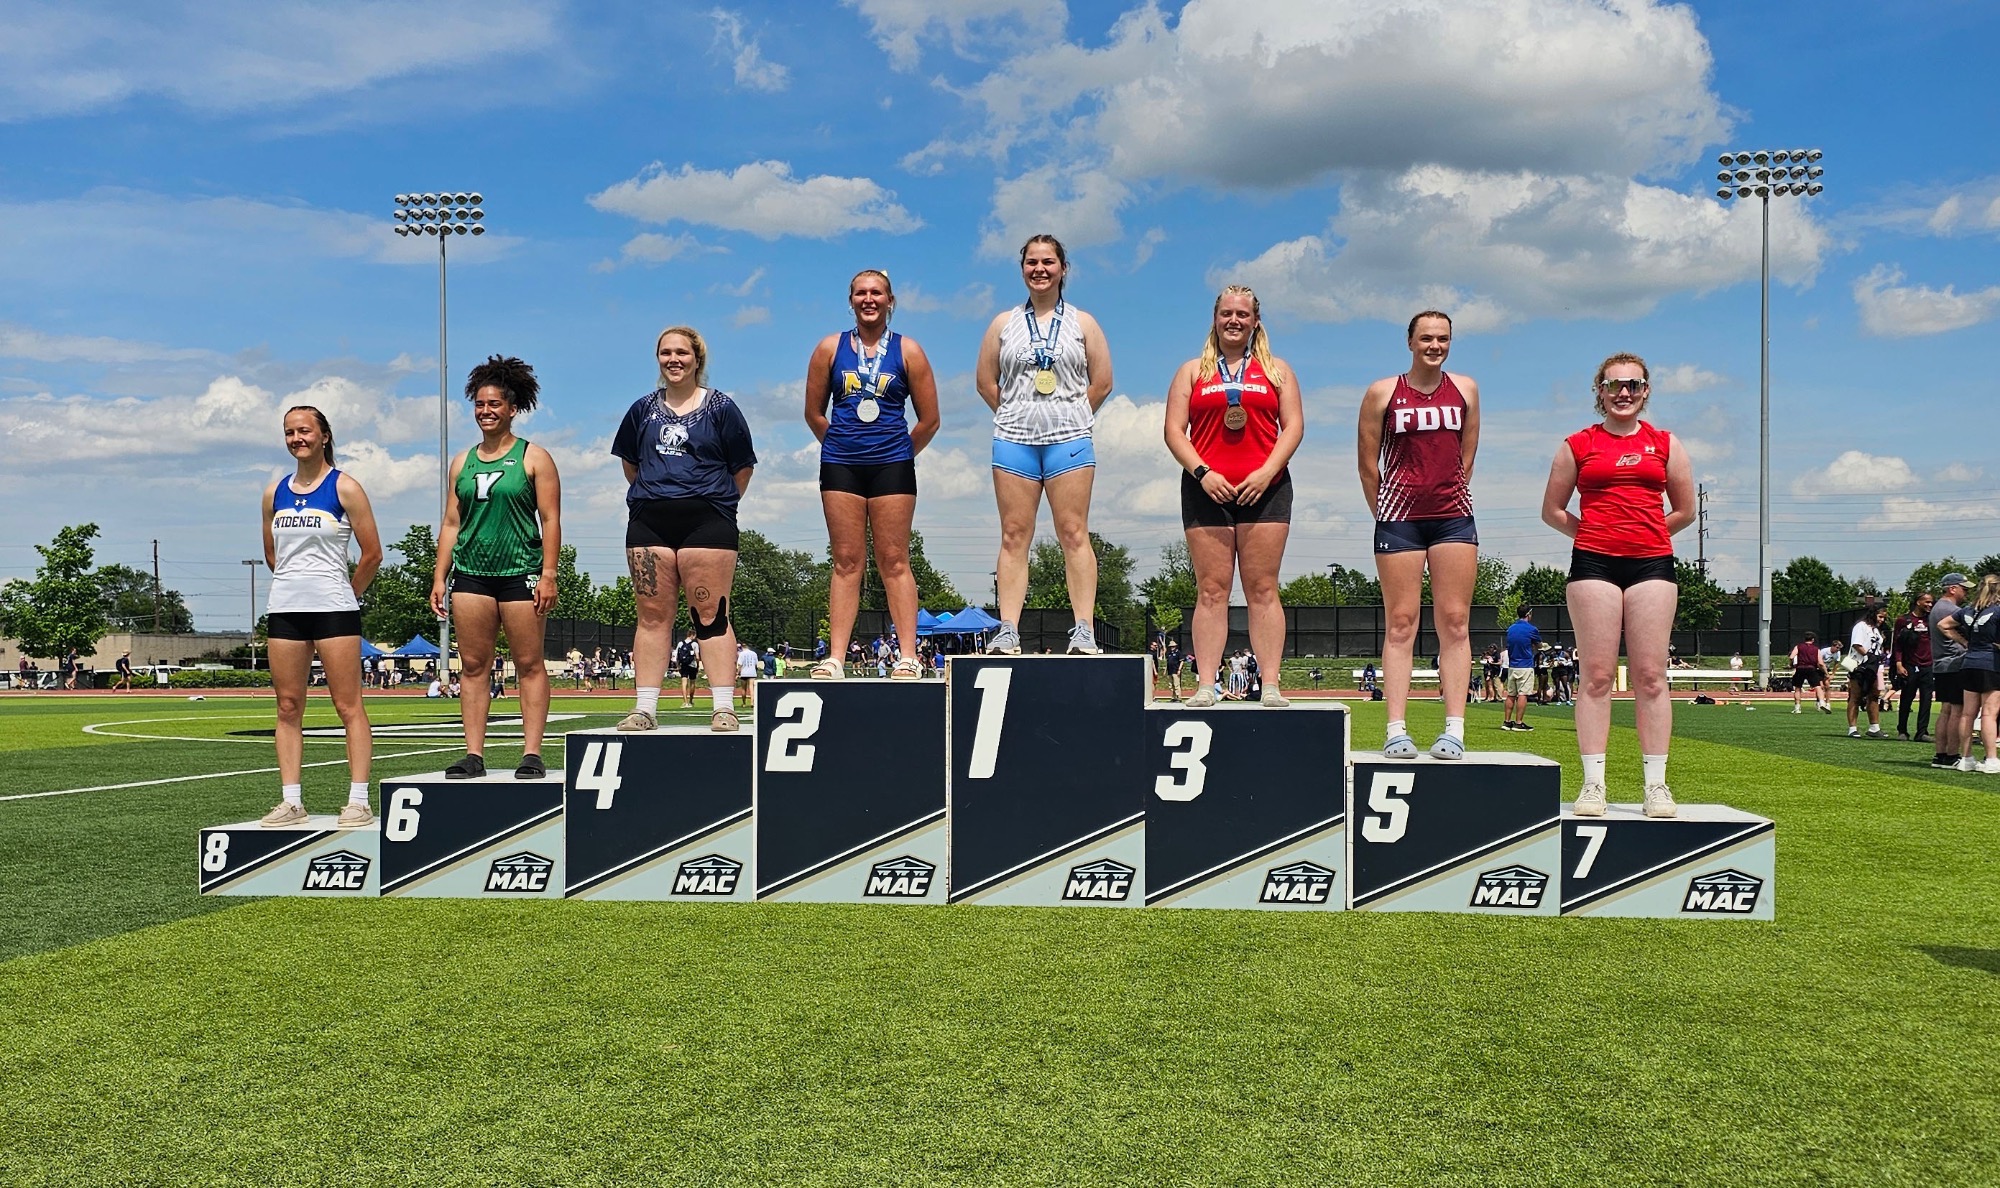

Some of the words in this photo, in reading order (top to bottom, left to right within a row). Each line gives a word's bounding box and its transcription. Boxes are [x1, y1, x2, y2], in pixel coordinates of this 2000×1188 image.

[1201, 383, 1268, 396] MONCHS
[1394, 406, 1462, 434] FDU
[472, 470, 505, 502] Y
[274, 515, 322, 529] WIDENER
[765, 692, 823, 772] 2
[969, 667, 1013, 779] 1
[1155, 721, 1213, 802] 3
[576, 743, 623, 810] 4
[386, 787, 423, 842] 6
[1362, 772, 1416, 843] 5
[203, 833, 230, 872] 8
[1573, 826, 1608, 879] 7
[306, 870, 364, 888] MAC
[489, 872, 548, 890] MAC
[676, 875, 736, 893] MAC
[868, 876, 929, 894] MAC
[1067, 880, 1129, 899] MAC
[1264, 882, 1328, 902] MAC
[1475, 887, 1542, 906] MAC
[1686, 890, 1756, 911] MAC
